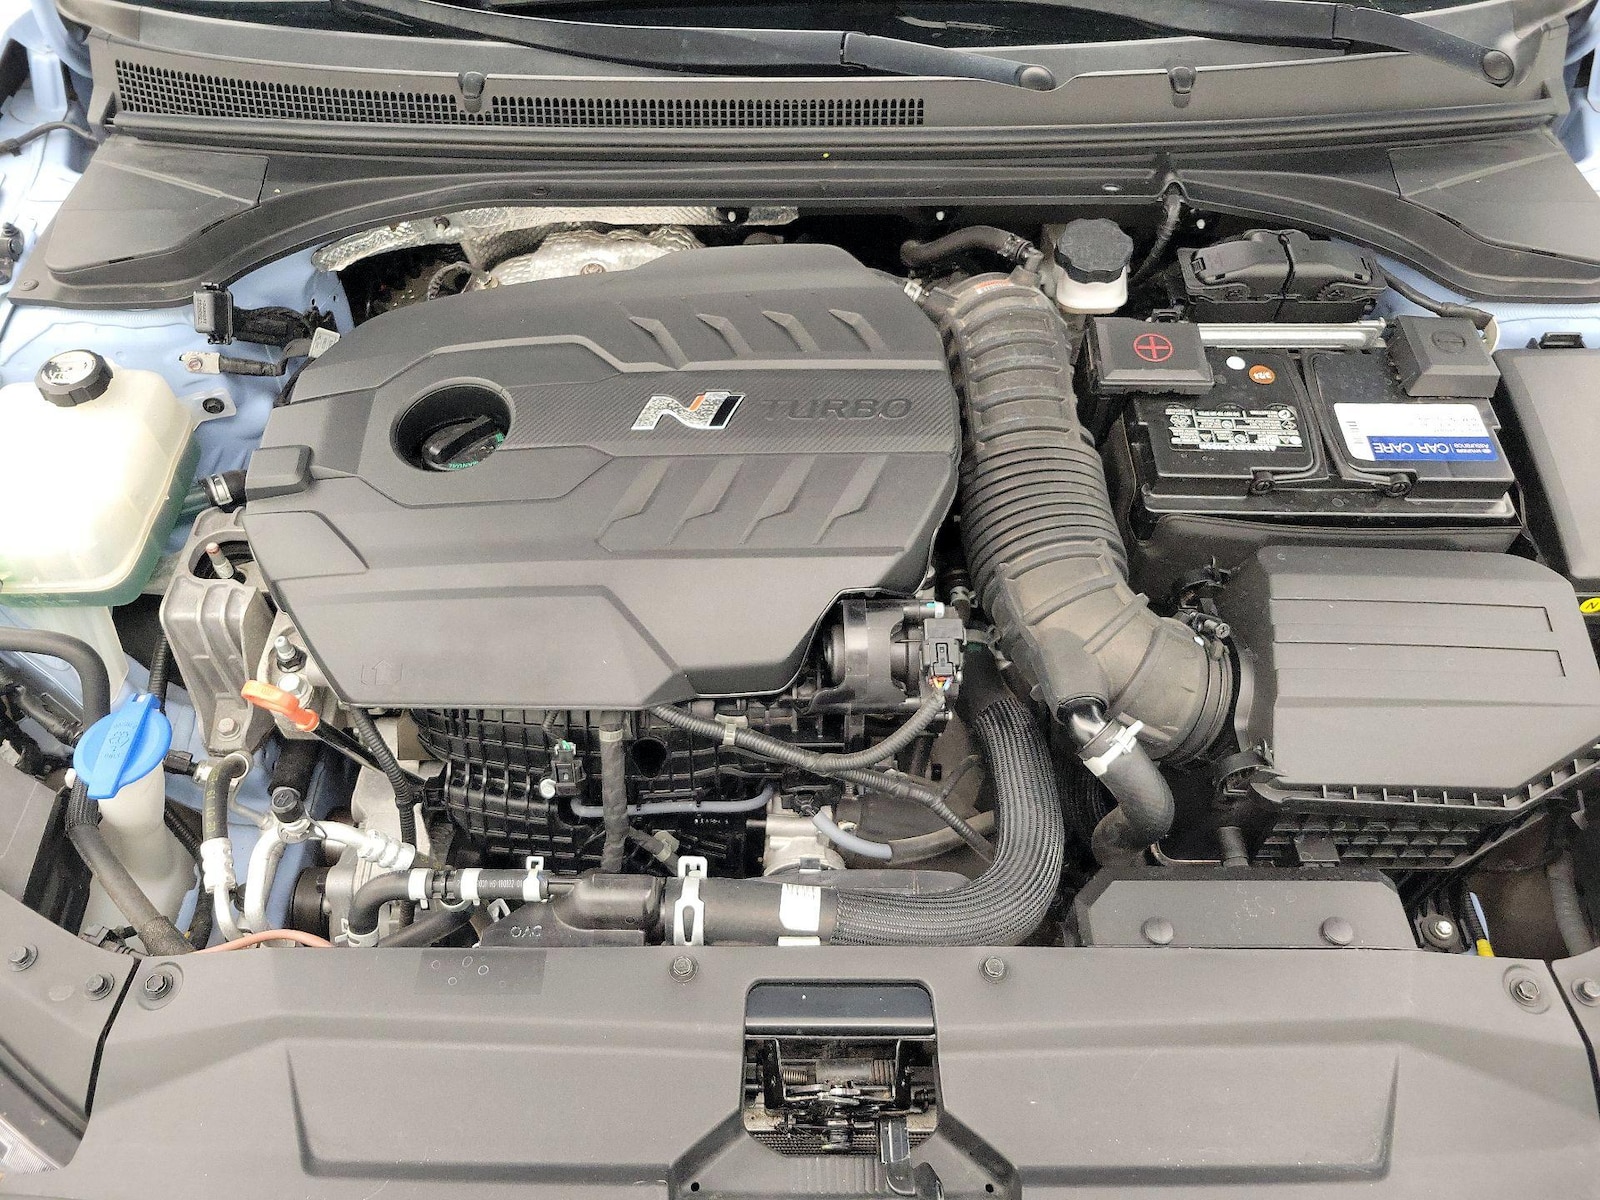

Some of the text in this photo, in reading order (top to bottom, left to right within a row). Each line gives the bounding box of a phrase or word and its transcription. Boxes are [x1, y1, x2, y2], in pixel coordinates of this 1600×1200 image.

[631, 390, 913, 431] N TURBO
[1372, 442, 1450, 454] CAR CARE
